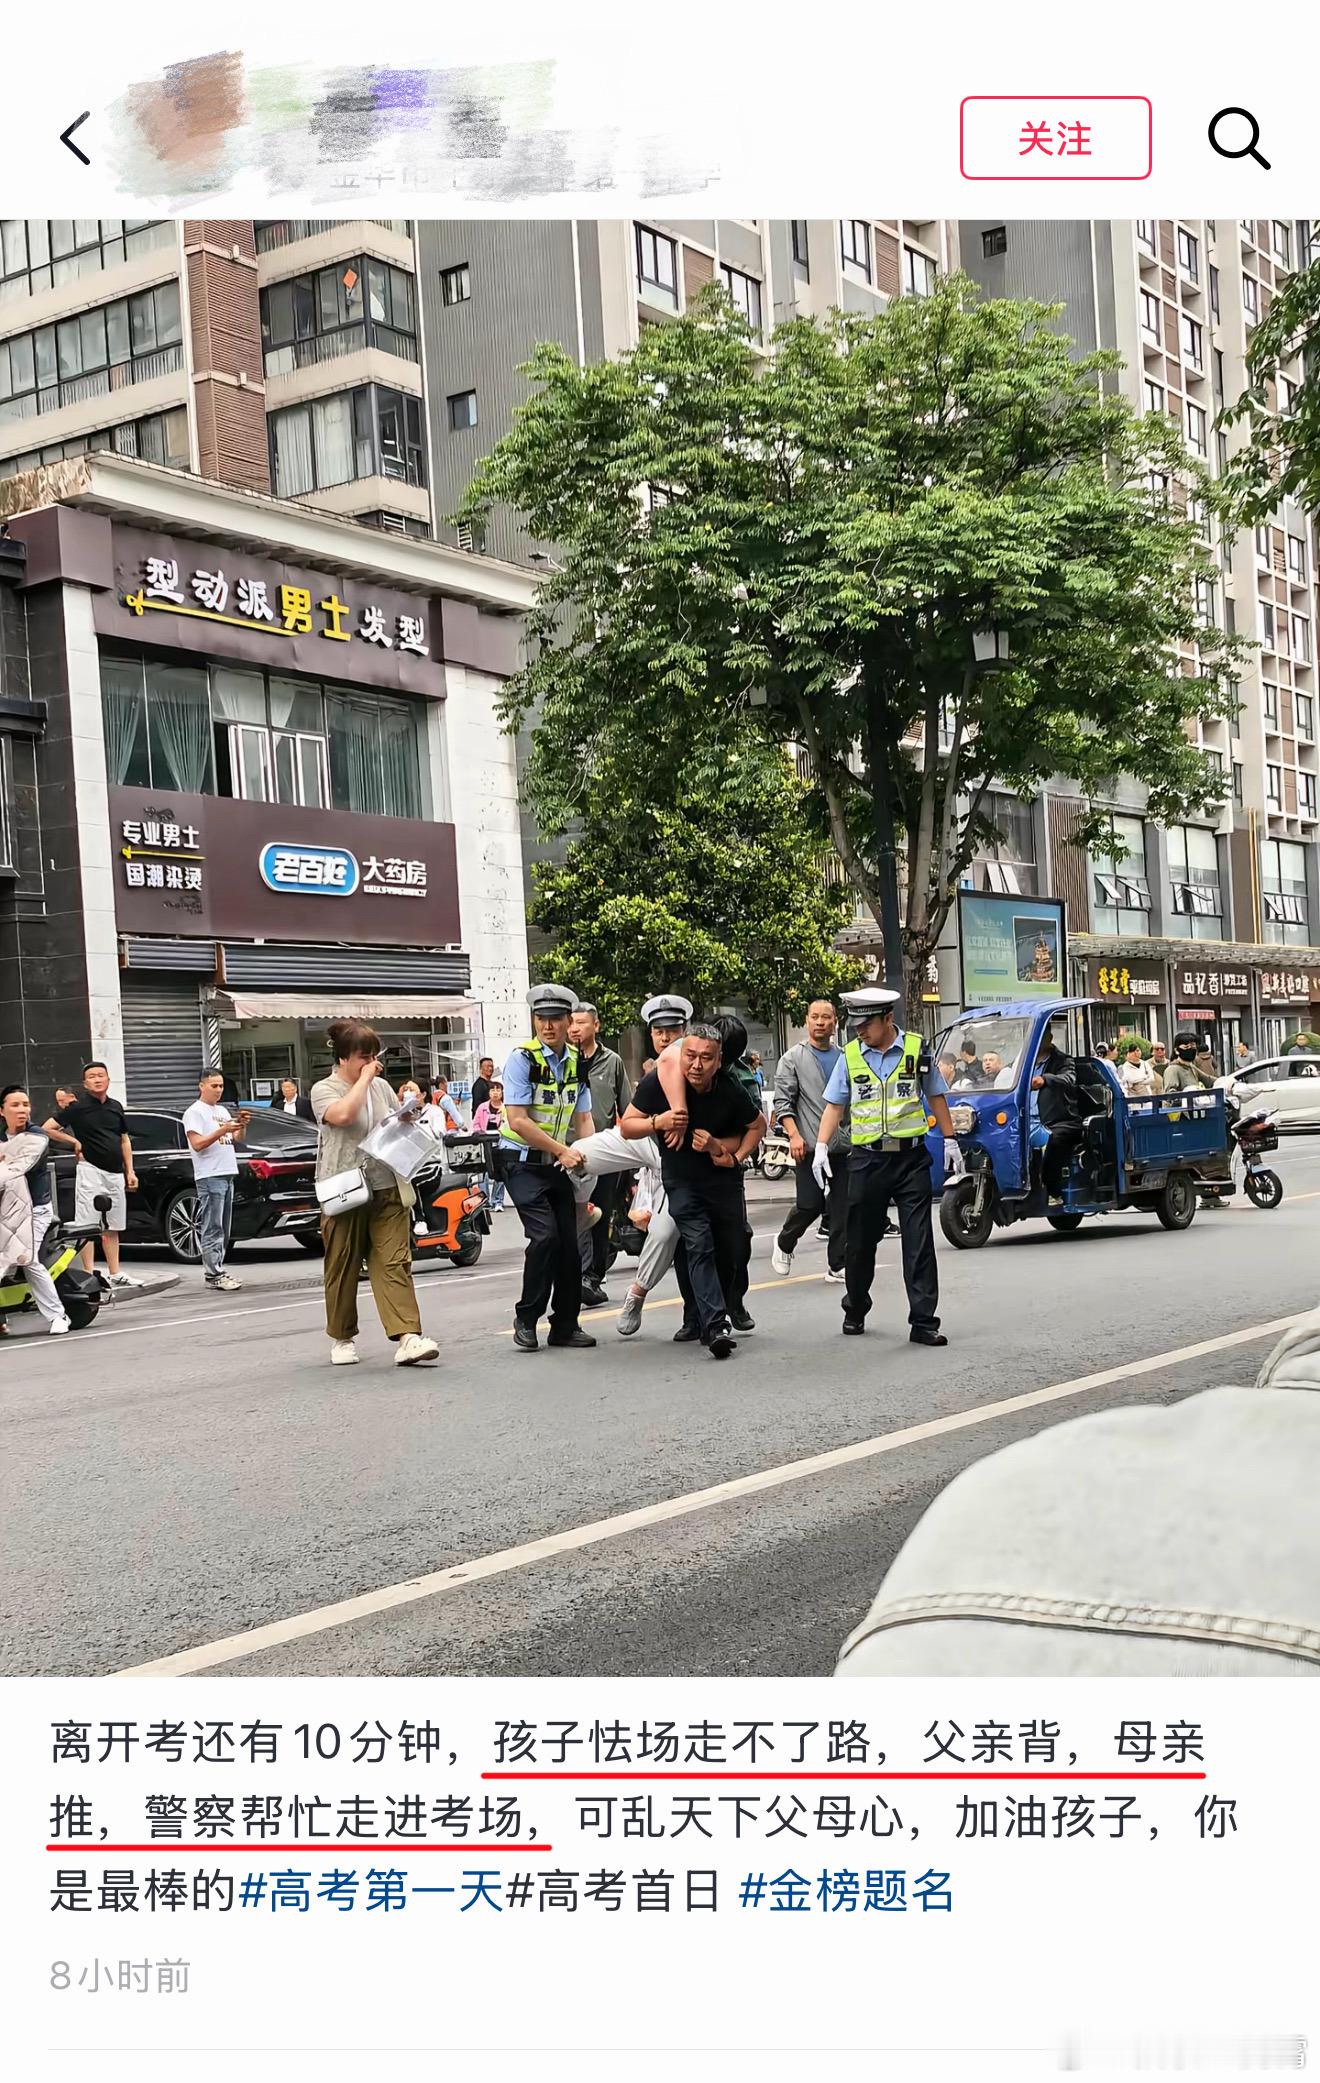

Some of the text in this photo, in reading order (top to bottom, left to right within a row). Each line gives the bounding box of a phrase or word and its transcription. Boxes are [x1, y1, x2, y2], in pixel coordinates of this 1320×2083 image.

[146, 557, 430, 657] 型动派男士发型
[123, 820, 200, 849] 专业男士
[362, 856, 427, 886] 大药房
